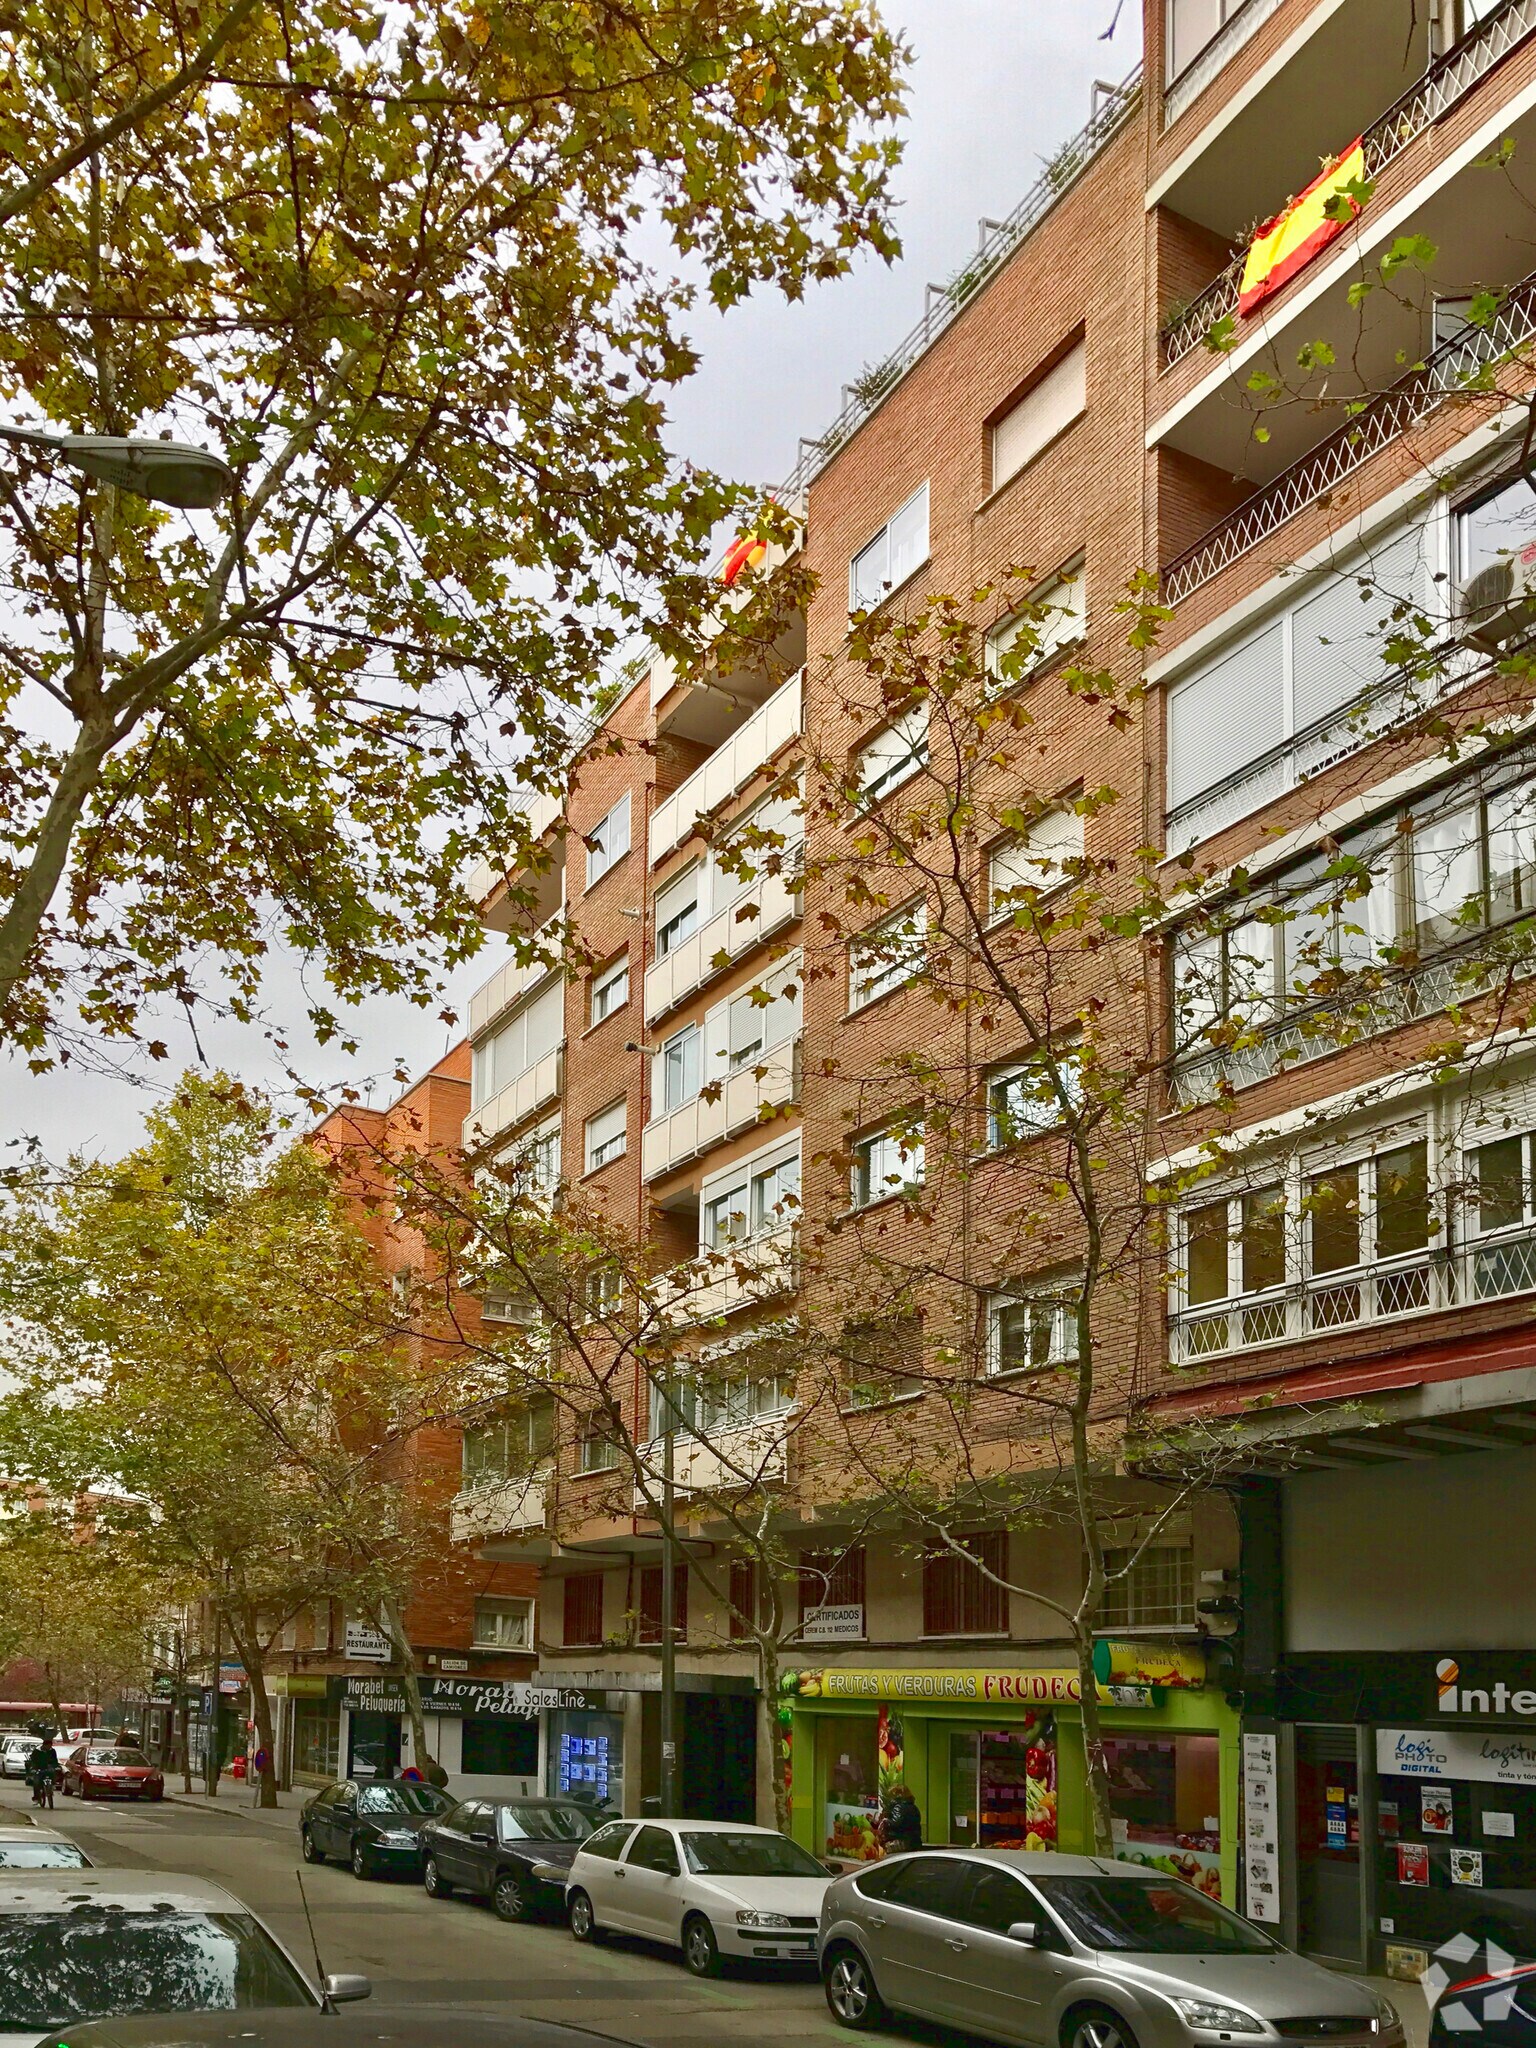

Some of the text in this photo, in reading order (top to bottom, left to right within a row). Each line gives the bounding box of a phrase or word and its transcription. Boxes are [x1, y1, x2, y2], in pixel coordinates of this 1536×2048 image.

[807, 1609, 860, 1621] CRTIFICADOS
[834, 1625, 859, 1633] MEDICOS
[346, 1639, 391, 1650] RESTAURANTE
[347, 1677, 385, 1694] Morabet
[828, 1674, 879, 1695] FRUTAS
[882, 1675, 893, 1695] Y
[894, 1675, 977, 1698] VERDURAS
[360, 1694, 406, 1713] Peluquería
[524, 1689, 586, 1709] SalesLine
[1395, 1734, 1435, 1762] logi
[1395, 1752, 1447, 1763] PHOTO
[1400, 1763, 1442, 1774] DIGITAL
[1497, 1771, 1515, 1779] tinta
[1516, 1773, 1522, 1781] y
